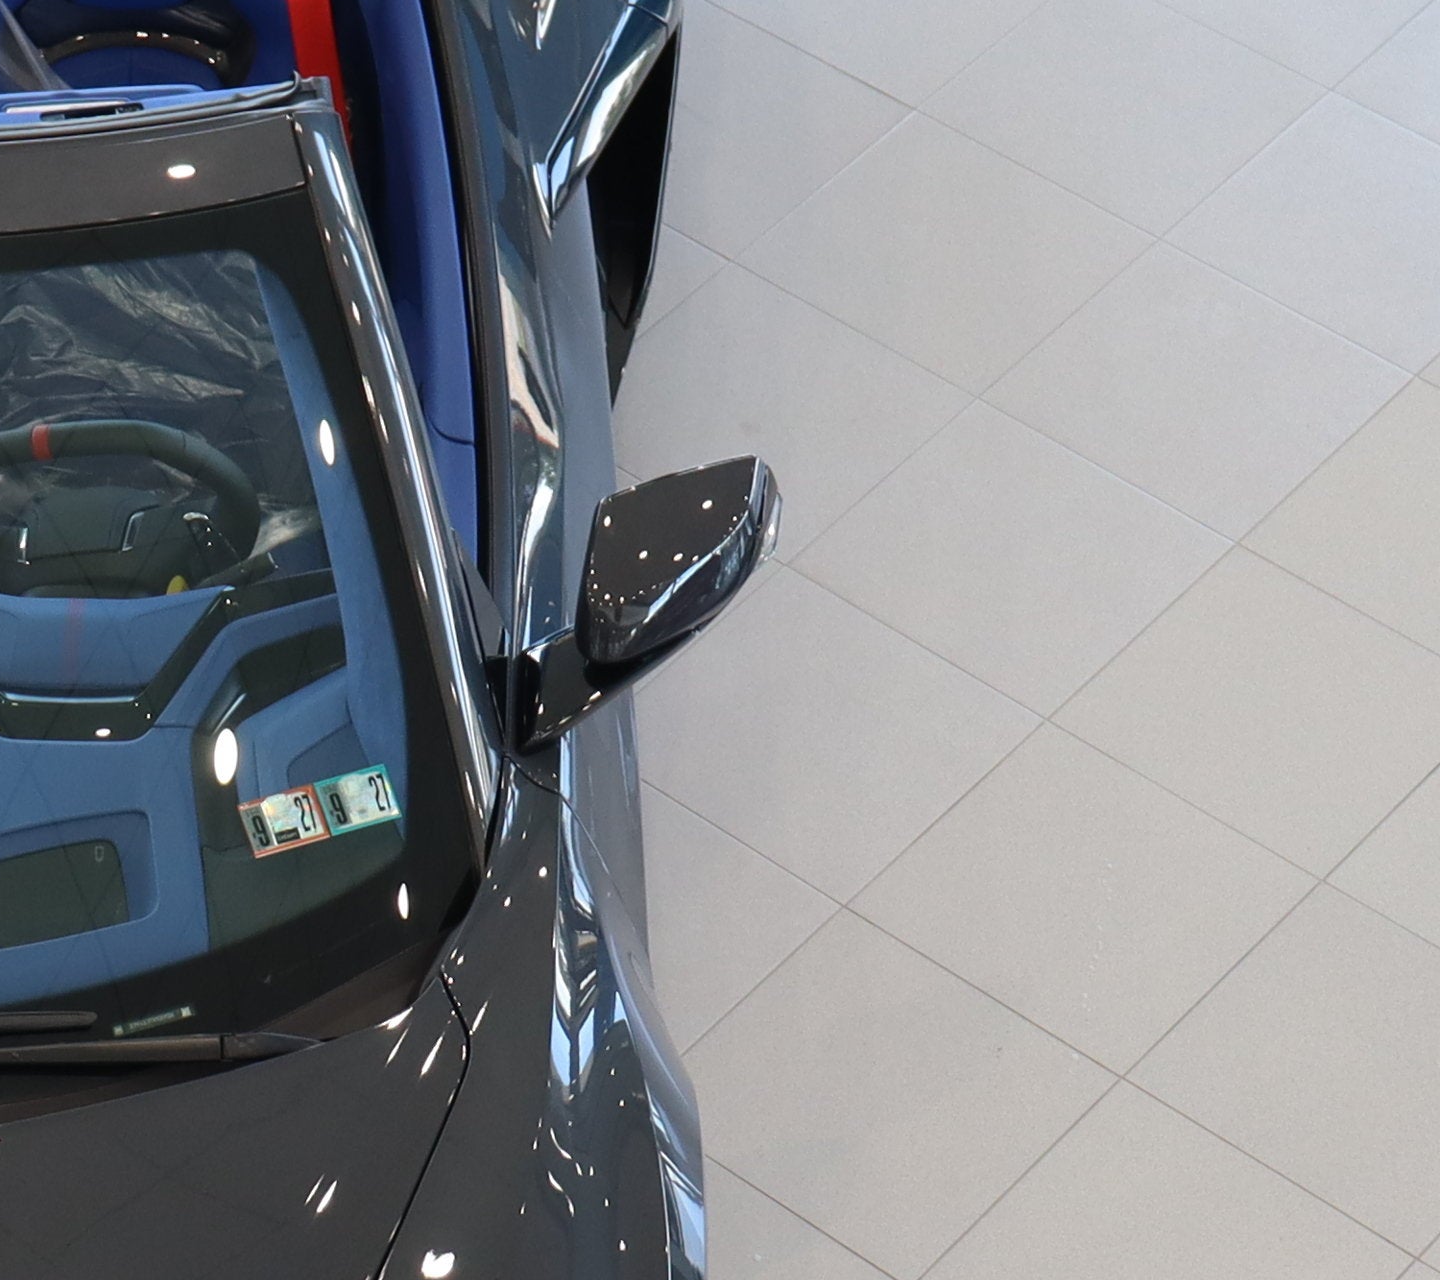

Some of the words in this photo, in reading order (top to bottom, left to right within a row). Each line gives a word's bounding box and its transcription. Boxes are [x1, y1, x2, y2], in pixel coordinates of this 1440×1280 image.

[251, 815, 271, 847] 9
[293, 793, 317, 833] 27
[328, 792, 348, 824] 9
[368, 773, 391, 812] 27
